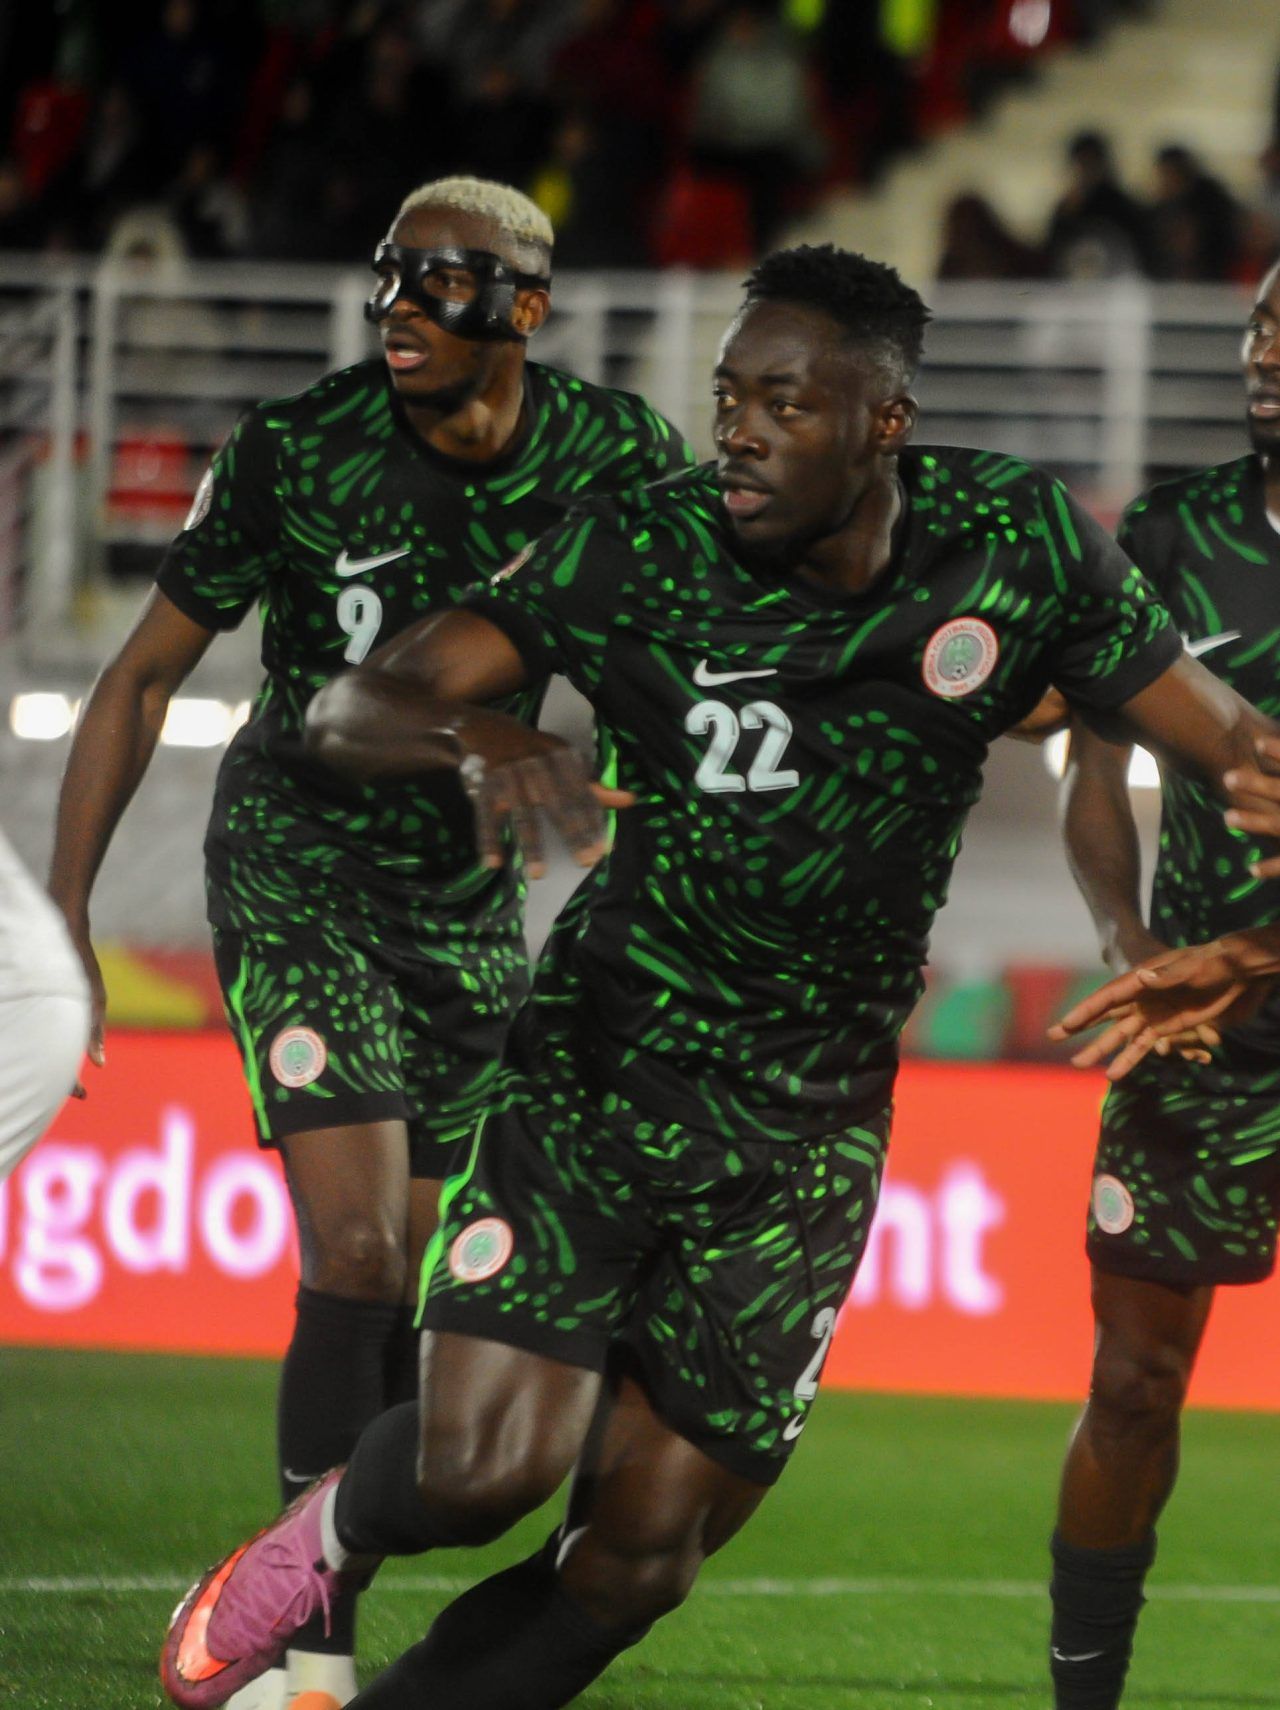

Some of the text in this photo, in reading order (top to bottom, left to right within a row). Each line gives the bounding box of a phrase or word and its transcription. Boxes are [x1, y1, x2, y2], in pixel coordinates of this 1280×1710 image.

[336, 585, 383, 666] 9
[685, 699, 800, 793] 22
[0, 1105, 299, 1310] gdo
